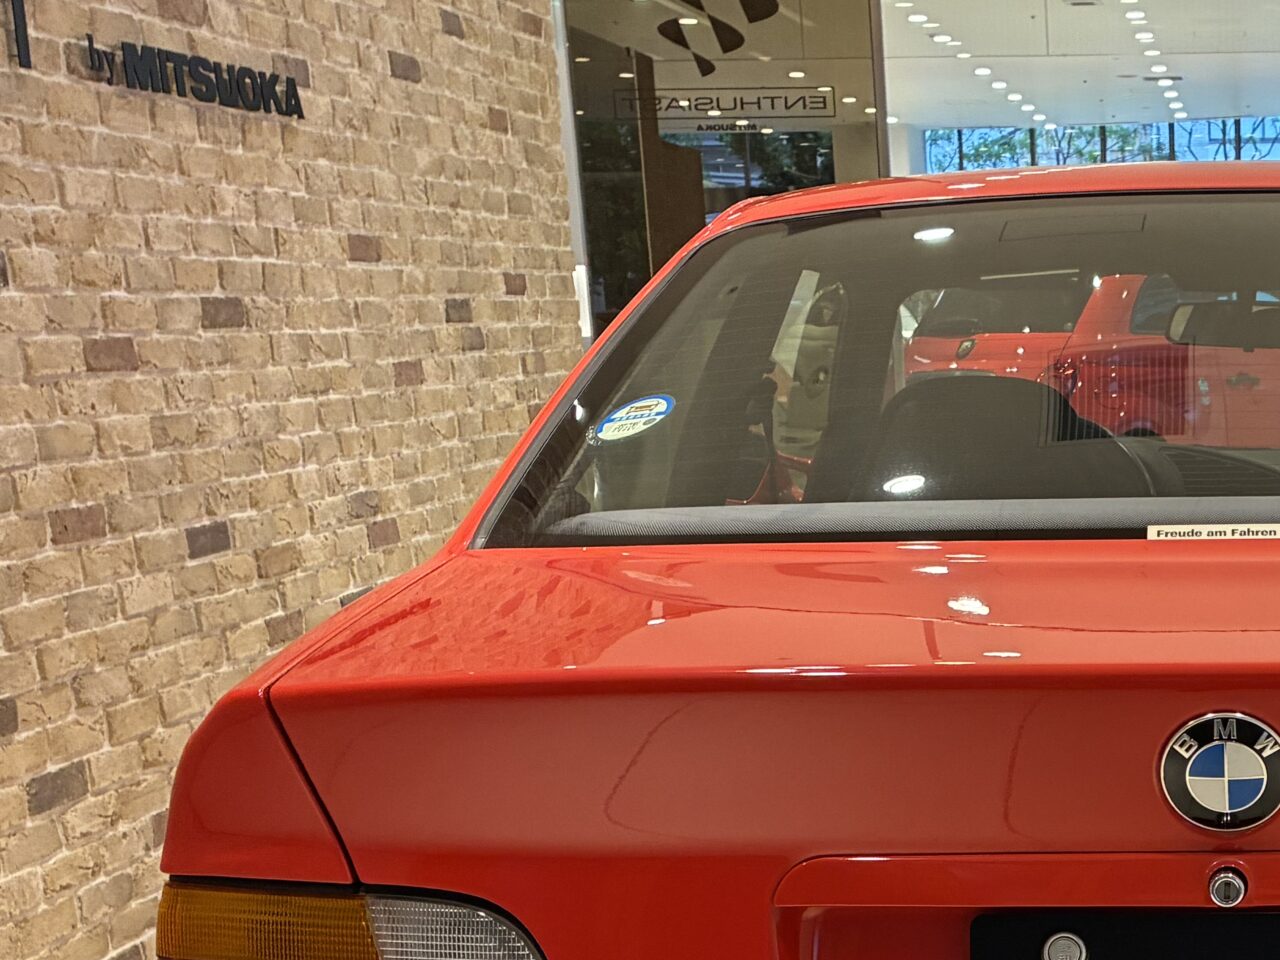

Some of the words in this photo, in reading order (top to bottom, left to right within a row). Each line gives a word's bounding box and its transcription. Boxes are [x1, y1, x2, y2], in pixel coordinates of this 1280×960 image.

[86, 33, 116, 86] by
[121, 42, 305, 119] MITSUOKA
[1156, 528, 1203, 538] Freude
[1206, 530, 1227, 538] am
[1231, 528, 1277, 537] Fahren
[1172, 719, 1280, 759] BMW
